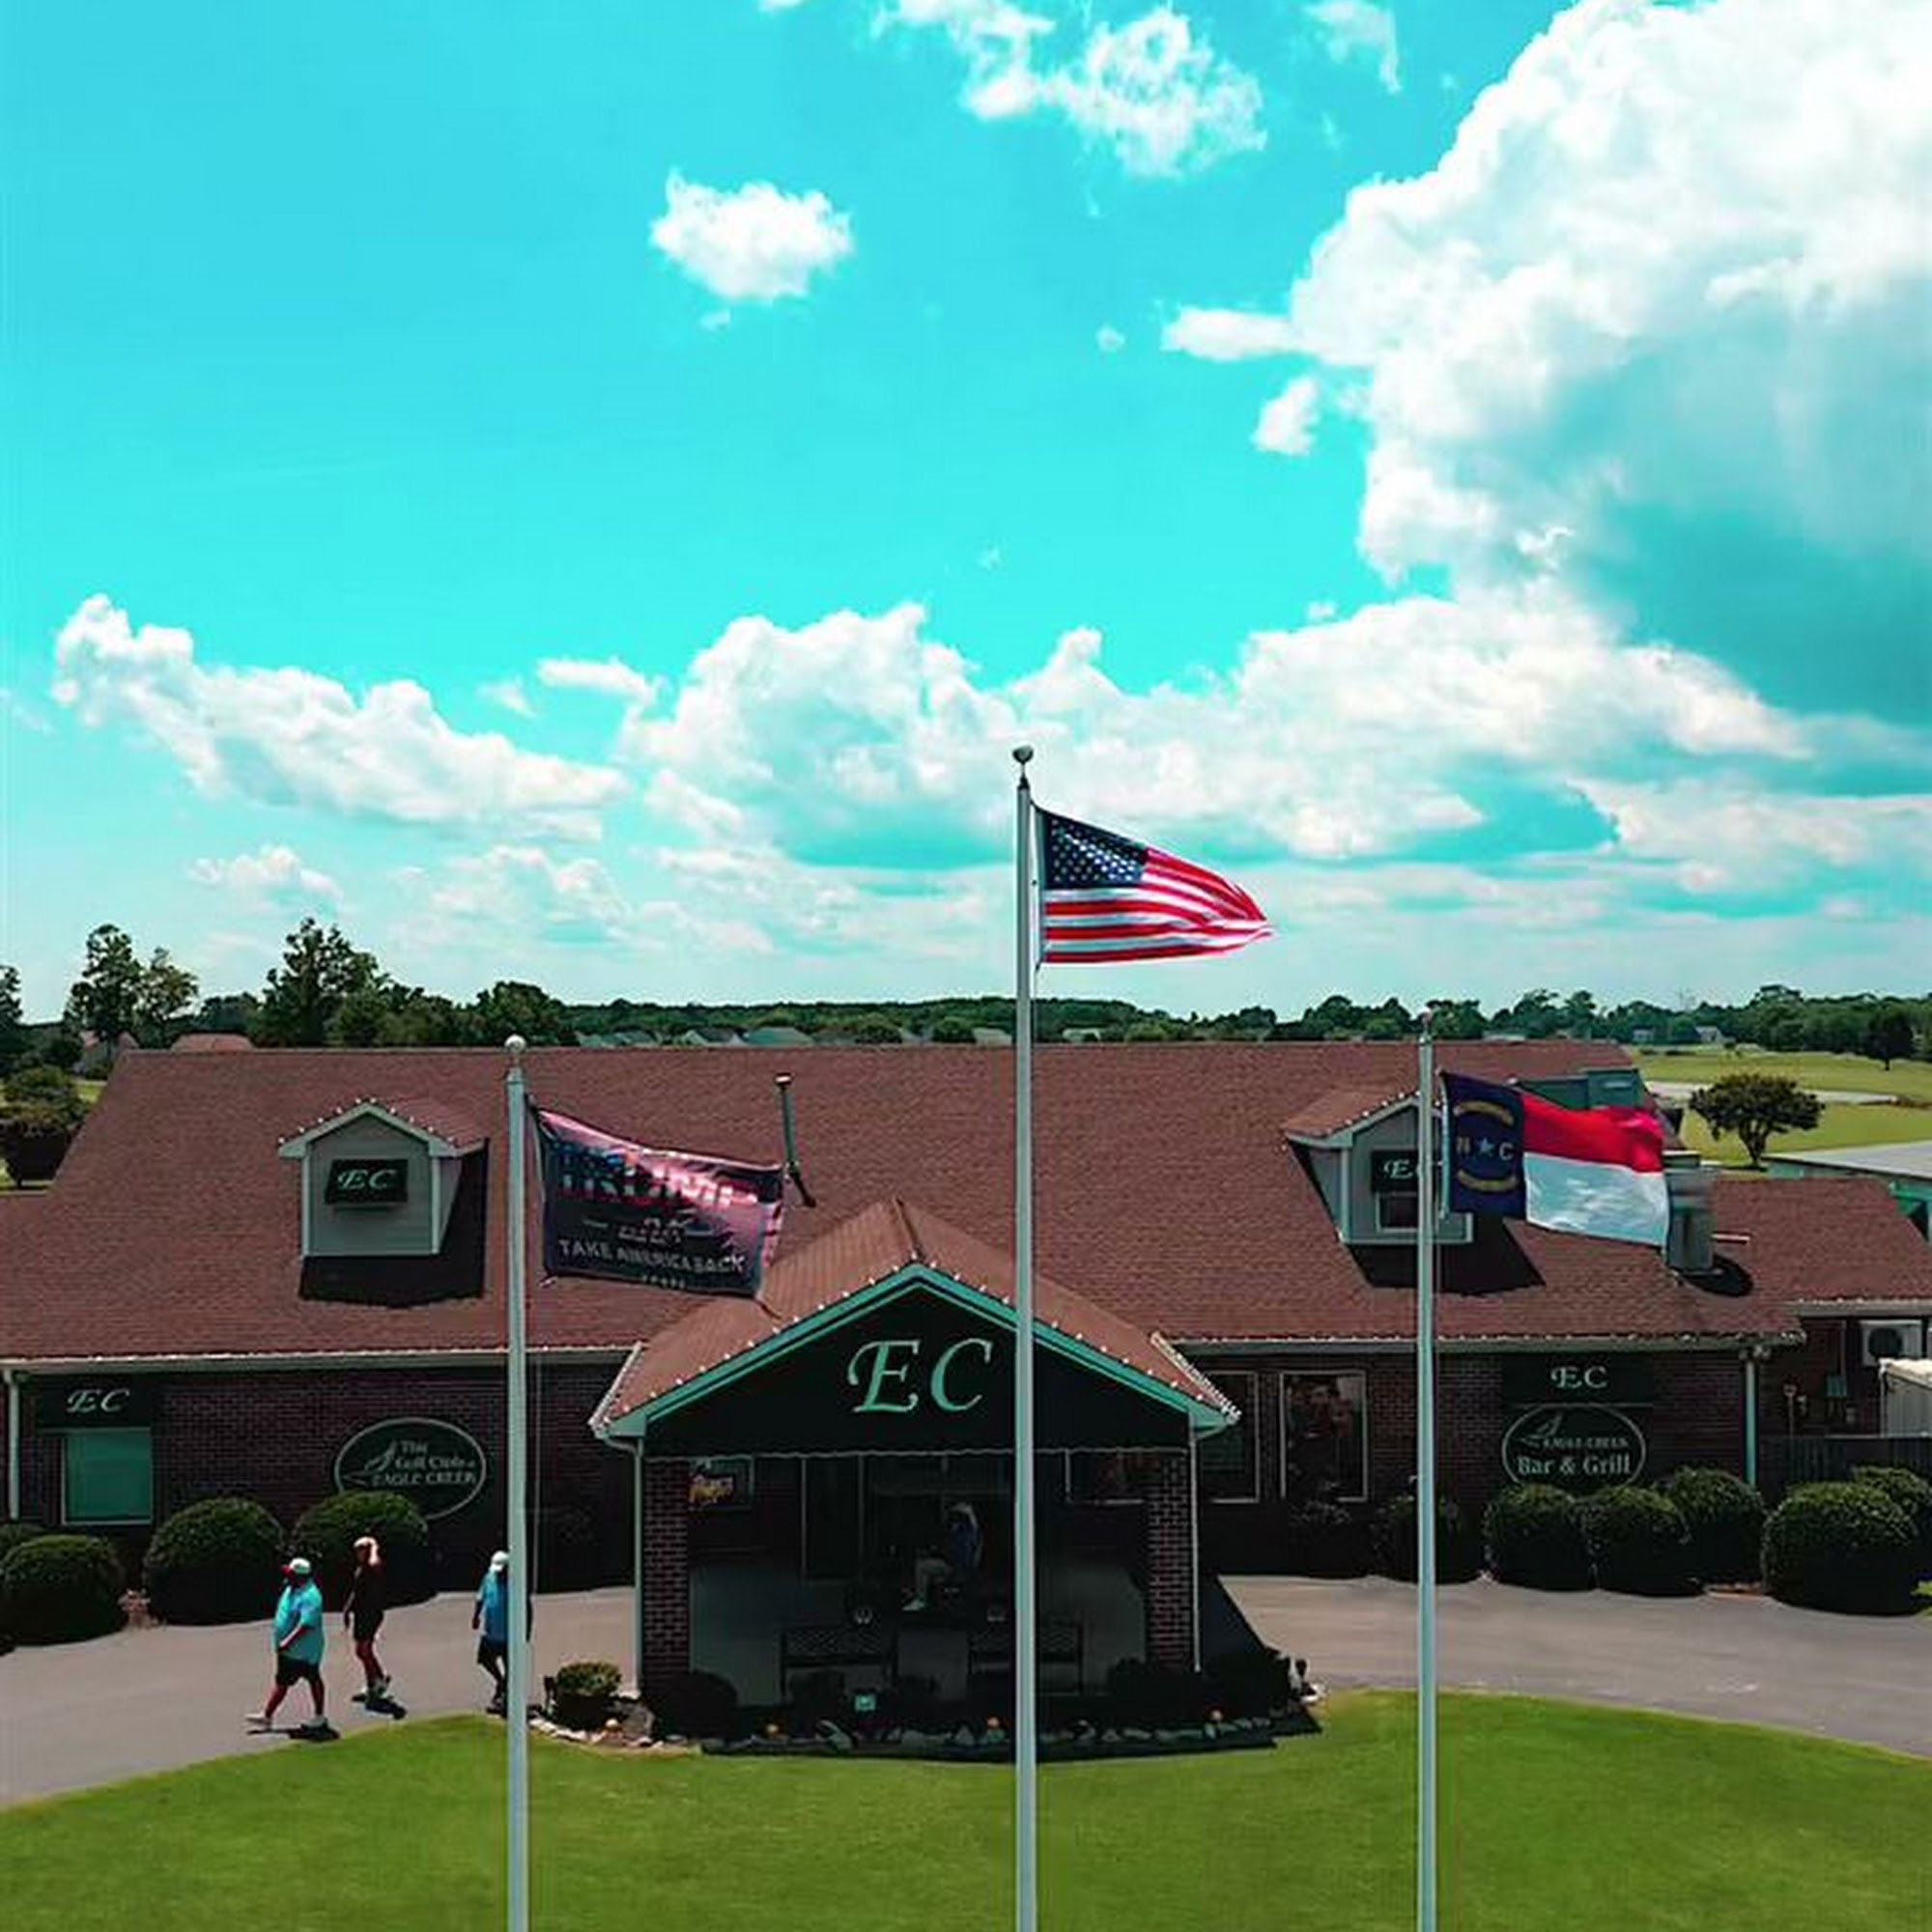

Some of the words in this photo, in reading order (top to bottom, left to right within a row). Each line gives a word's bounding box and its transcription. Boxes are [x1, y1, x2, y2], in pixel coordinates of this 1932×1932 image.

[1498, 1142, 1514, 1161] C
[337, 1169, 396, 1189] EC
[559, 1239, 611, 1261] TAKE
[695, 1254, 746, 1274] BACK
[847, 1337, 992, 1413] EC
[1550, 1365, 1609, 1389] EC
[67, 1388, 130, 1412] EC
[1517, 1455, 1554, 1476] Bar
[1559, 1456, 1577, 1475] &
[1582, 1451, 1632, 1476] Grill
